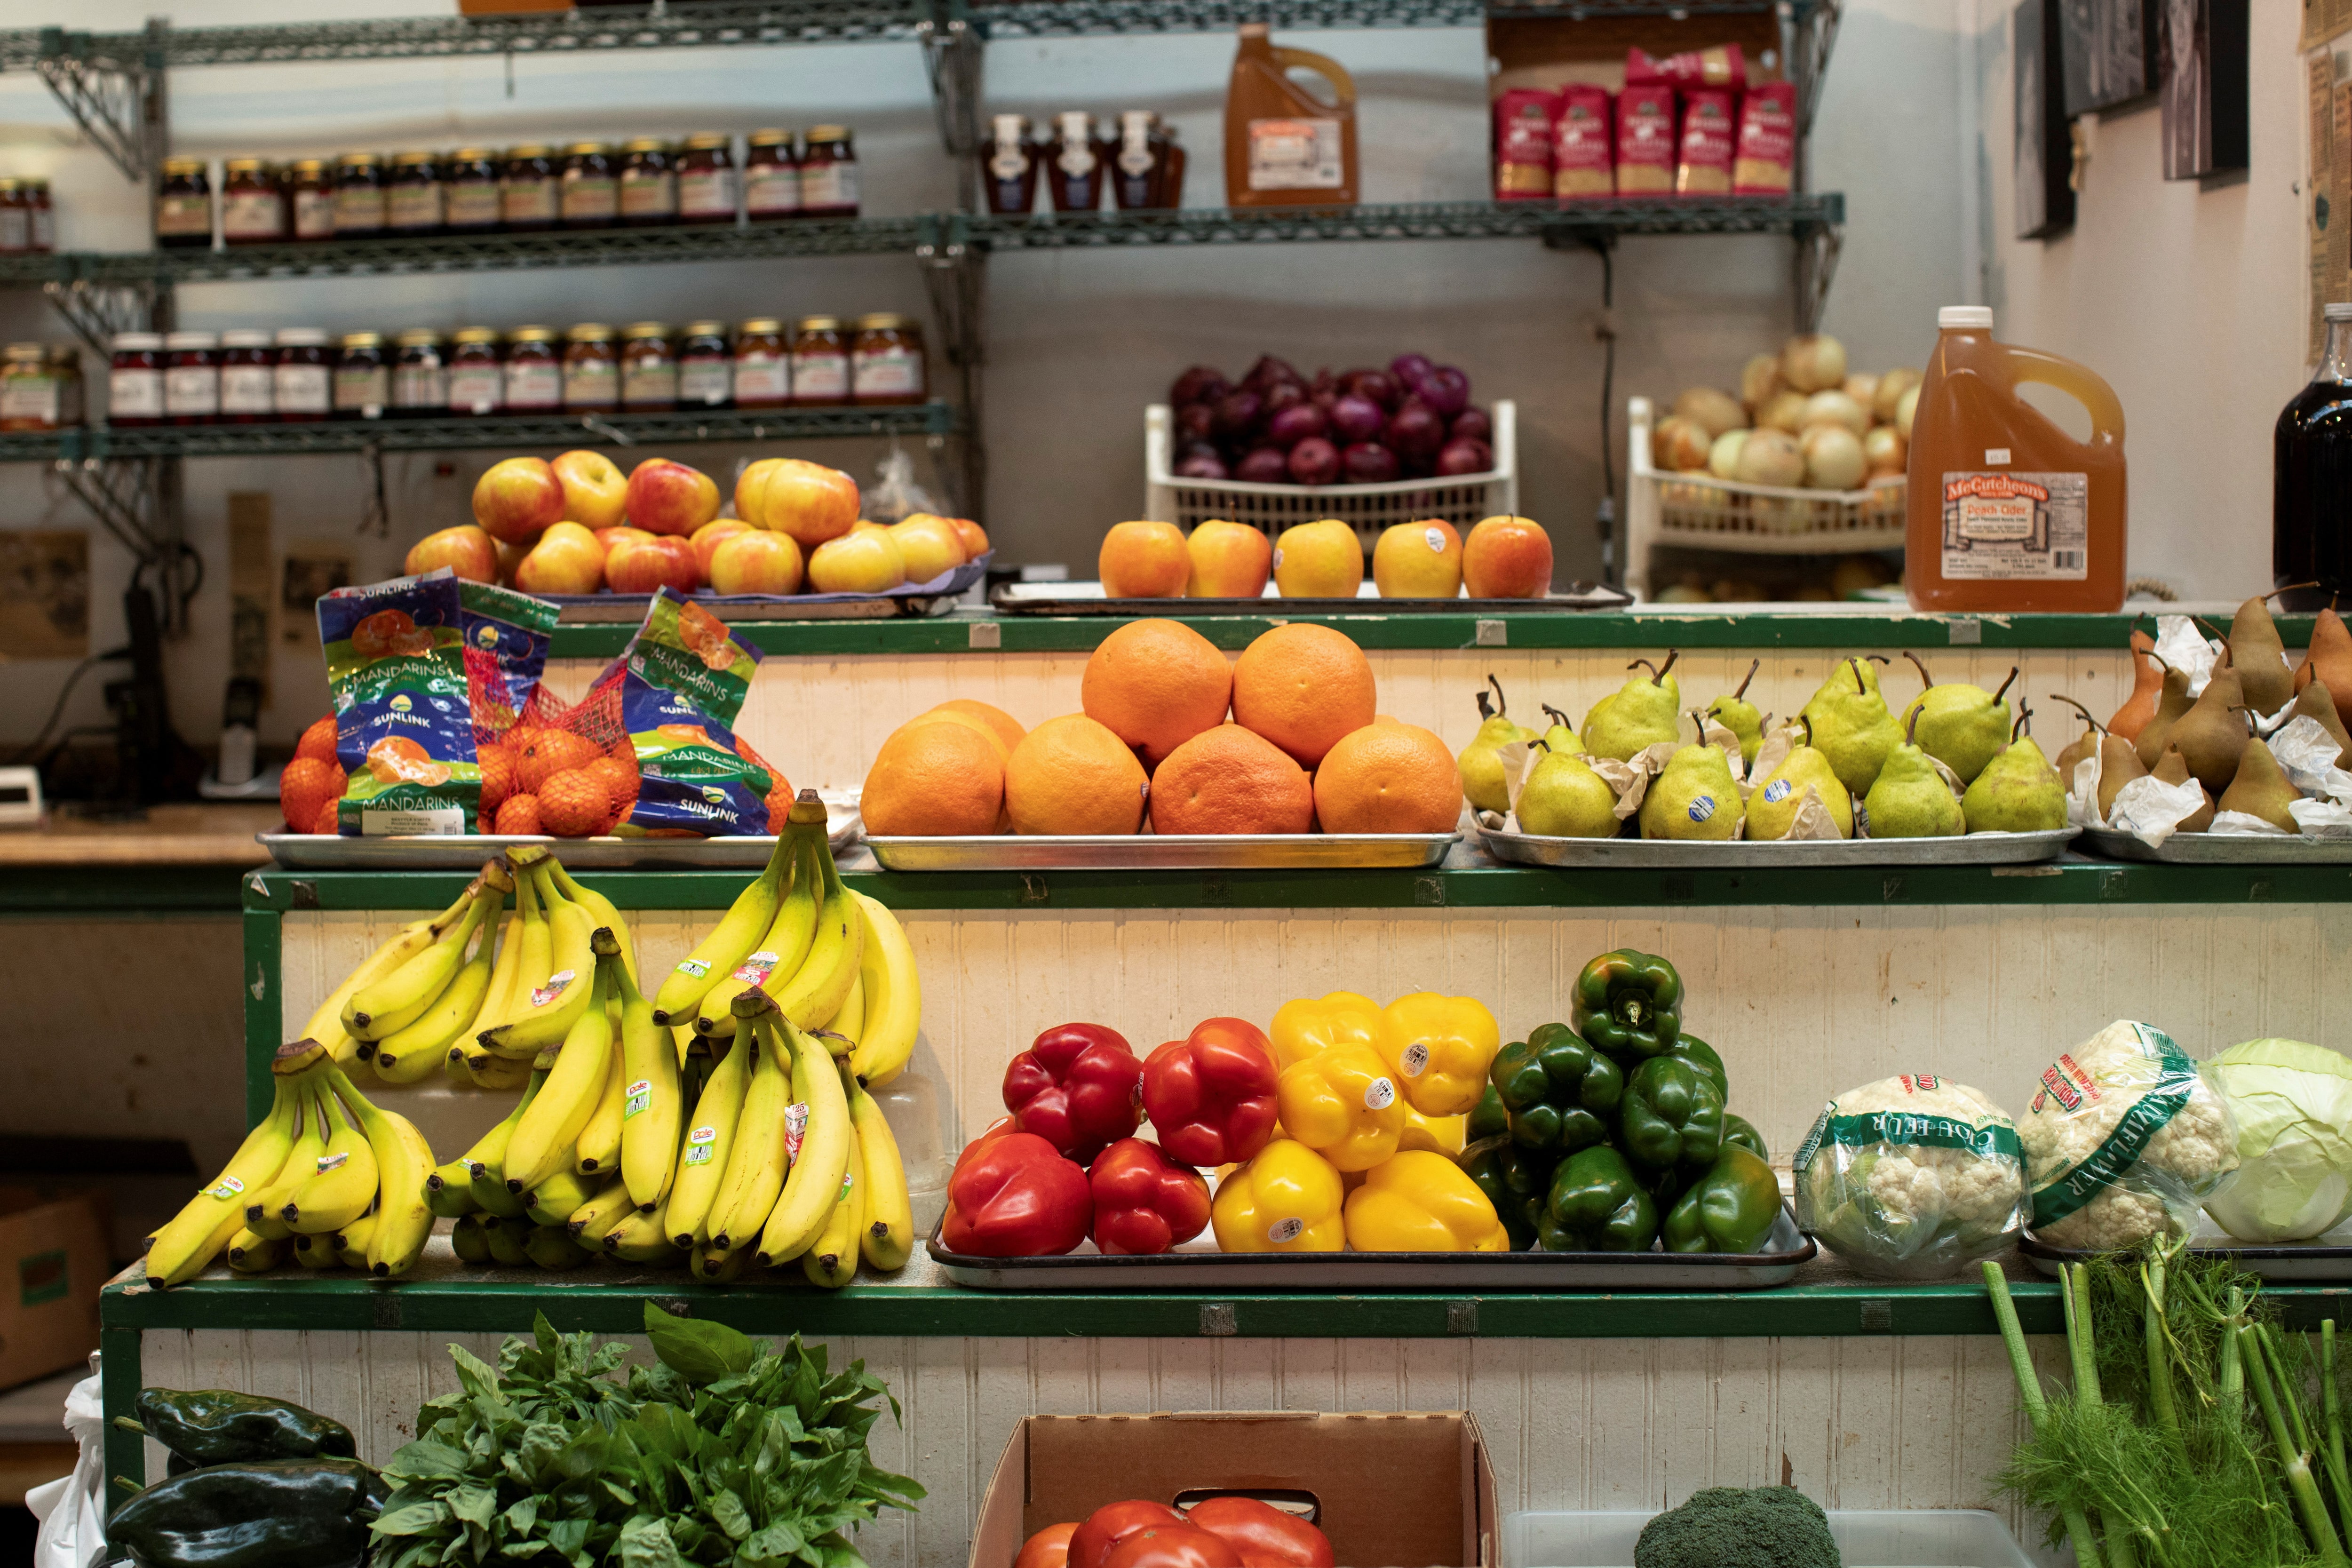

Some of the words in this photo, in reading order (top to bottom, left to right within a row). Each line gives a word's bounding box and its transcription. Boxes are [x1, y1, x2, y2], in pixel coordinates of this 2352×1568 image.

[359, 582, 417, 601] SUNLINK
[352, 662, 446, 685] MANDARINS
[650, 646, 728, 701] MANDARINS
[373, 712, 431, 729] SUNLINK
[662, 750, 757, 774] MANDARINS
[362, 796, 461, 811] MANDARINS
[678, 798, 739, 824] SUNLINK
[629, 1082, 647, 1094] Dole
[693, 1129, 713, 1138] Dole
